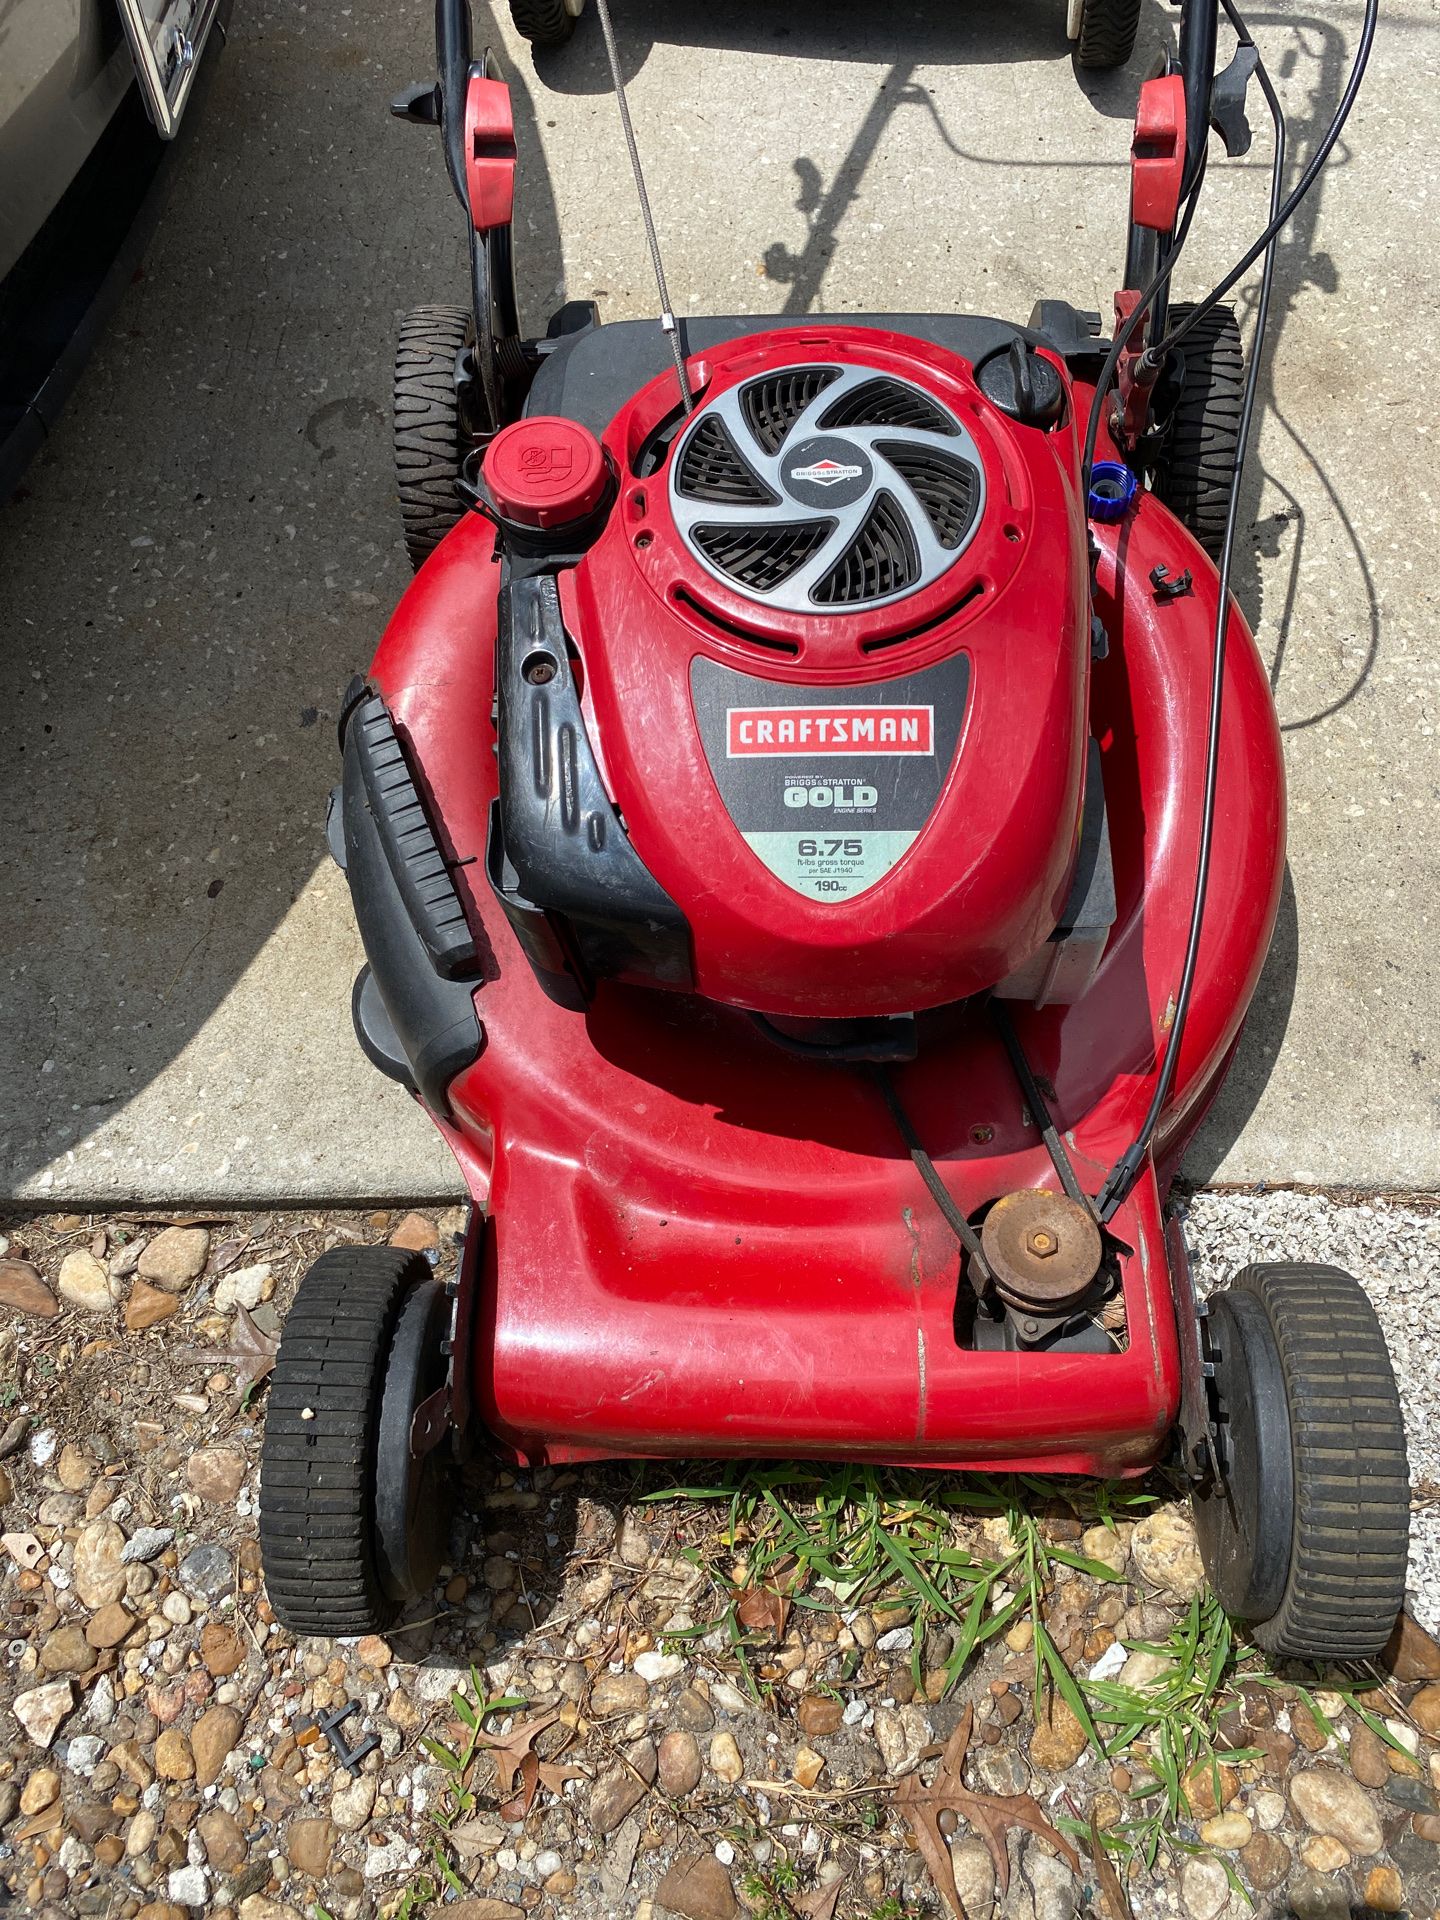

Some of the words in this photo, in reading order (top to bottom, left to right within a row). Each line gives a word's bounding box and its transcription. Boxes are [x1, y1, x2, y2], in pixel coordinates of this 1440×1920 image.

[739, 717, 919, 744] CRAFTSMAN
[783, 786, 878, 807] GOLD
[798, 839, 863, 856] 6.75
[840, 859, 864, 867] torque
[815, 880, 848, 891] 190cc
